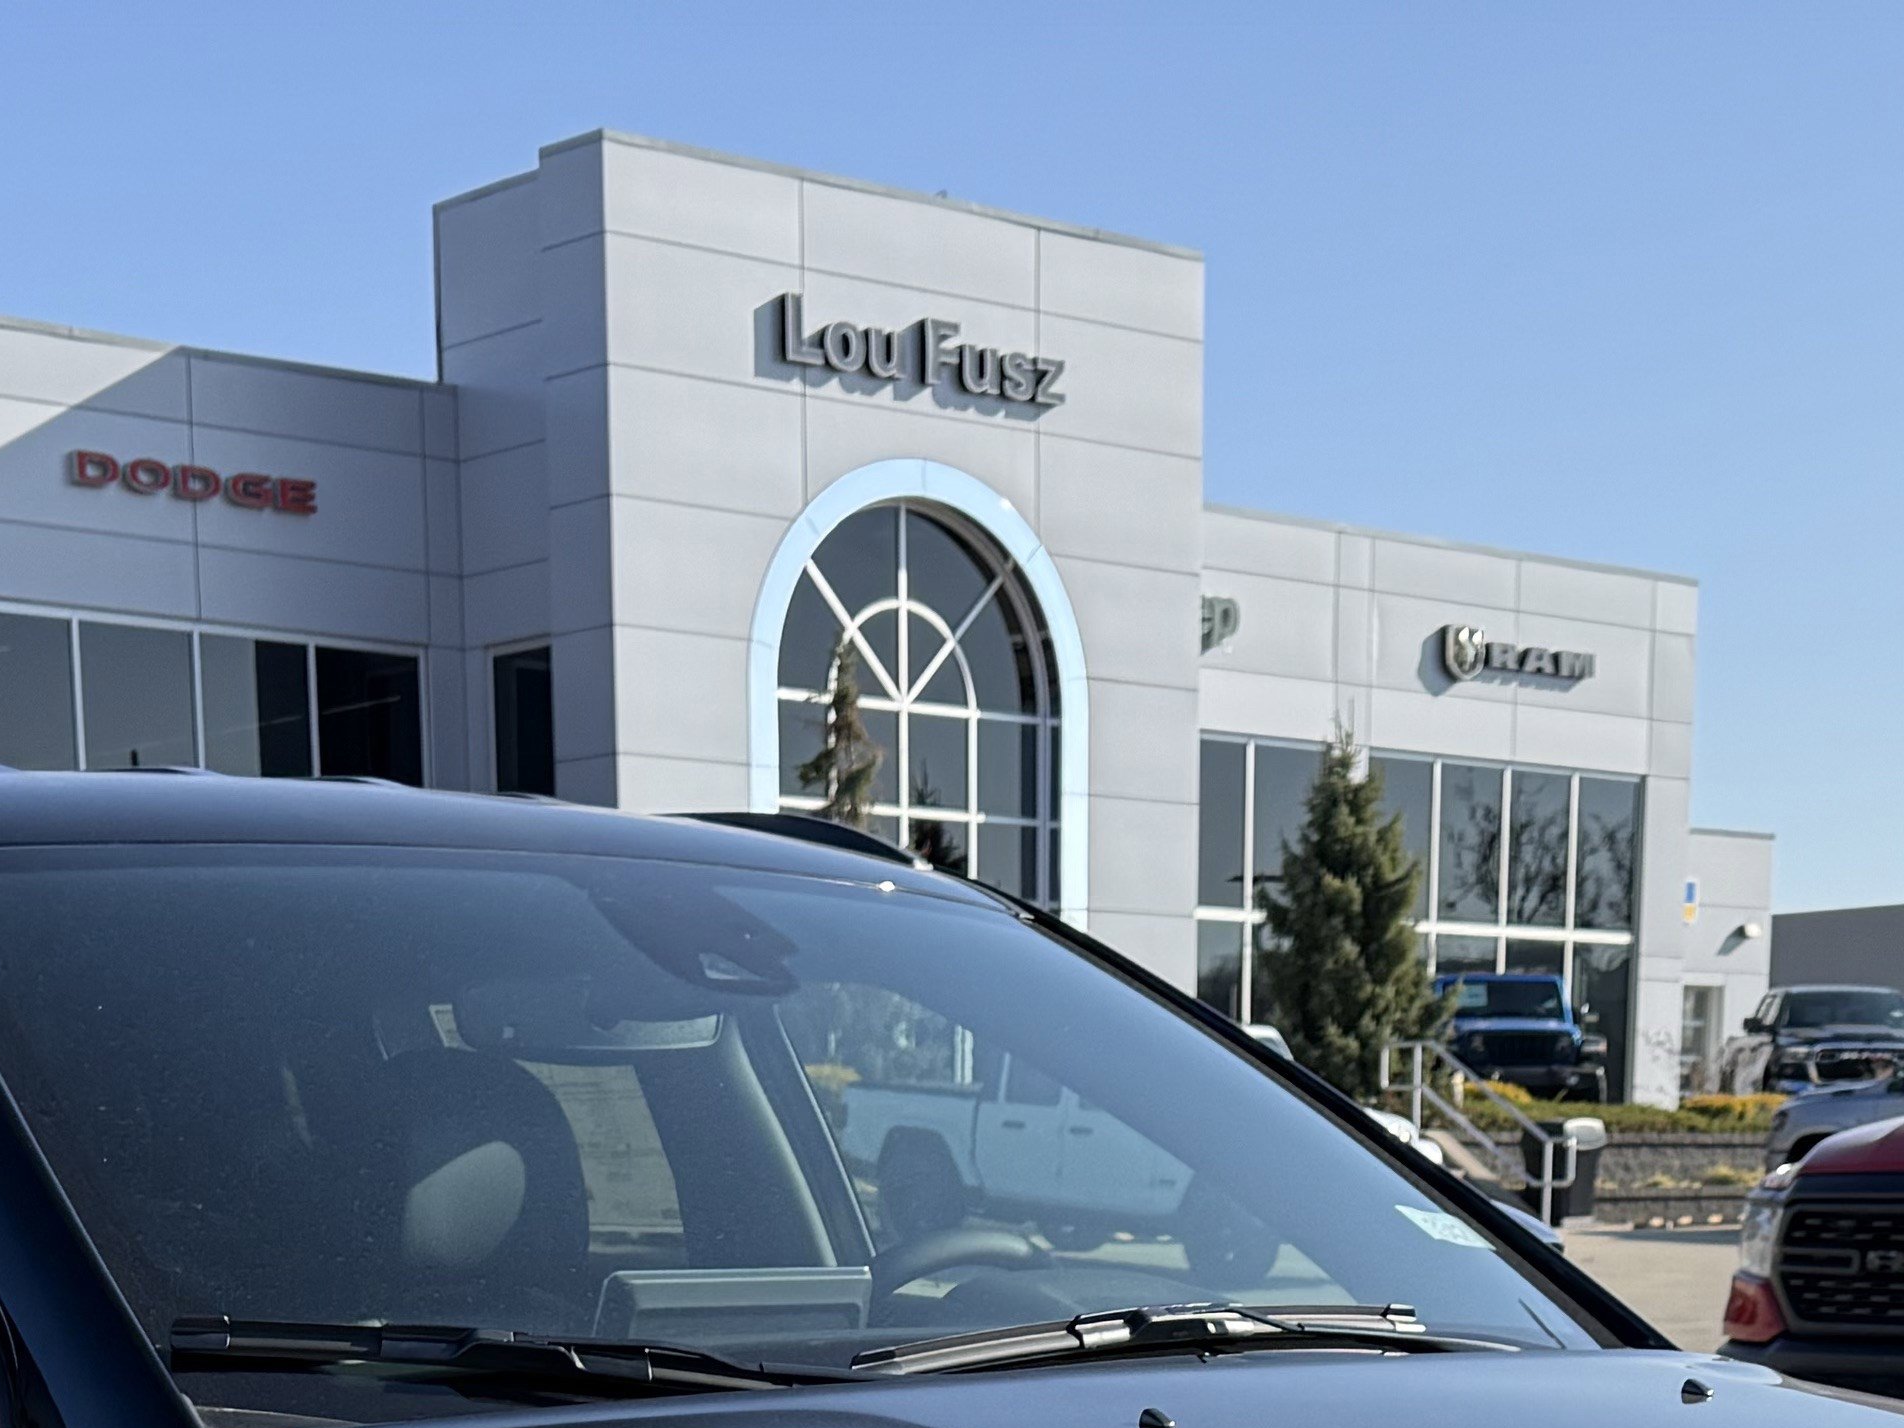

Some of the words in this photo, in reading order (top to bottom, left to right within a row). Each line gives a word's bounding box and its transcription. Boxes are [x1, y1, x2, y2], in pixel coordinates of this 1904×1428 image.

[780, 291, 902, 379] Lou
[920, 317, 1066, 405] Fusz
[69, 449, 318, 515] DODGE
[1484, 641, 1596, 681] RAM
